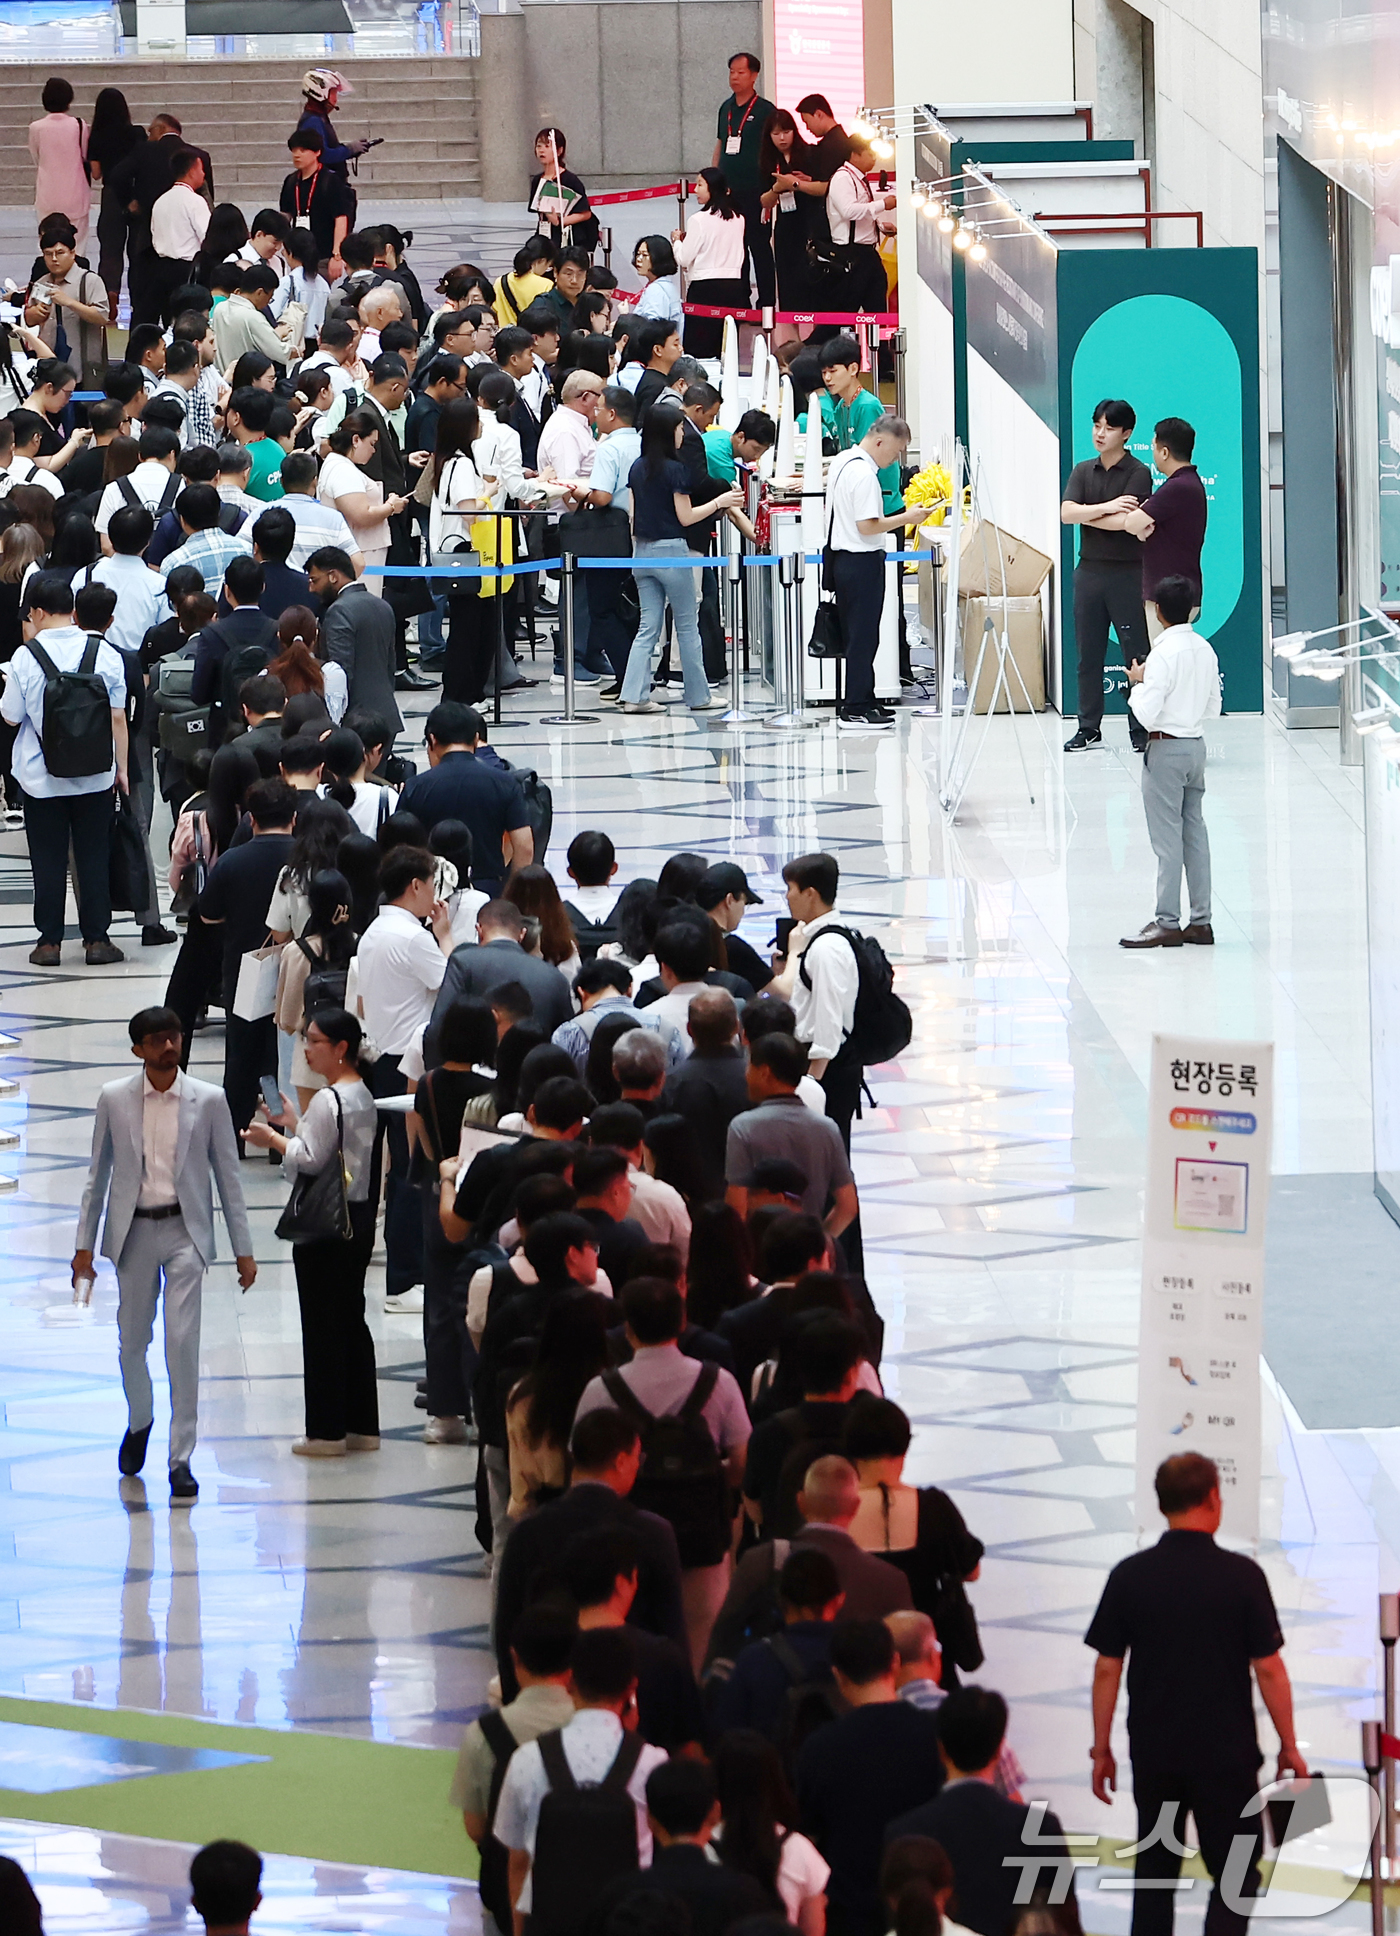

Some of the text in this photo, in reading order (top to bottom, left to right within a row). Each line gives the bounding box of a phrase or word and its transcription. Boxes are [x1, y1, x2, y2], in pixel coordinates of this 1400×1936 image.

[793, 314, 814, 322] coex
[855, 315, 876, 323] coex
[1170, 1058, 1258, 1097] 현장등록
